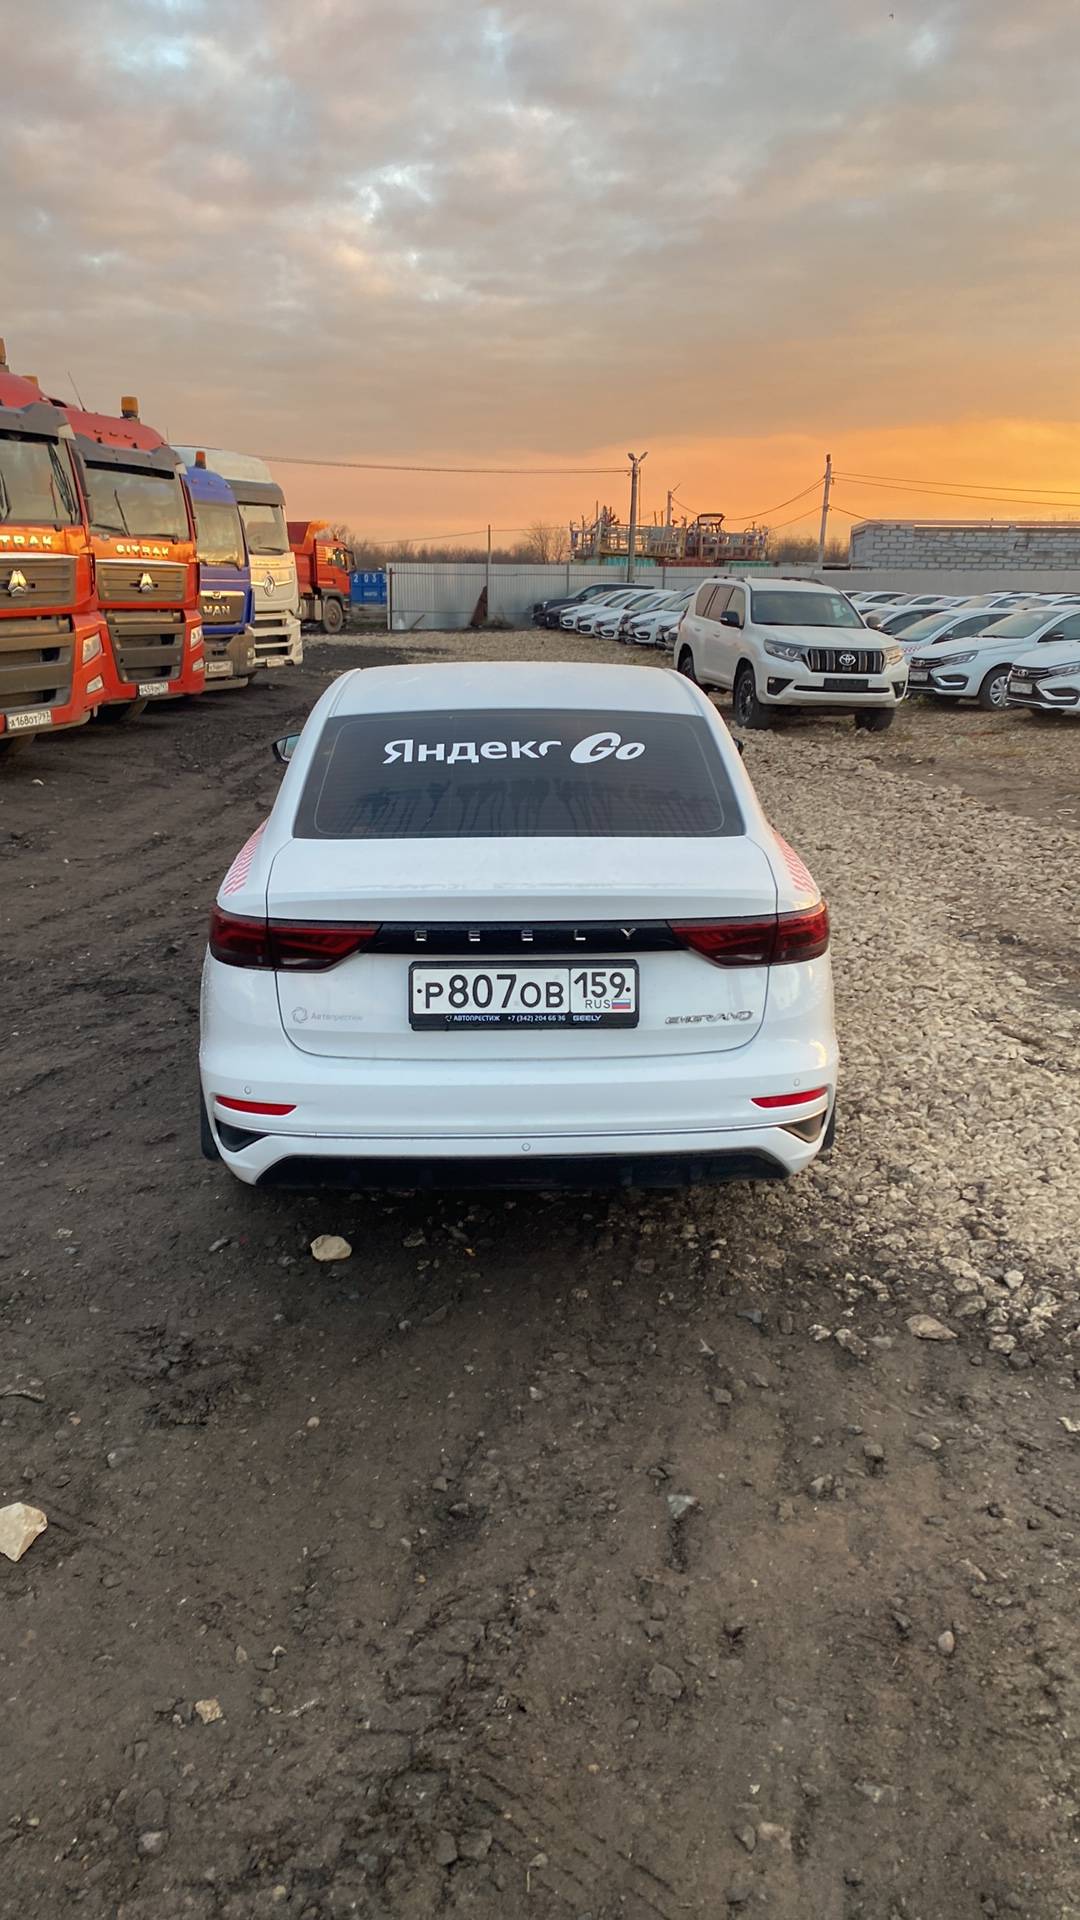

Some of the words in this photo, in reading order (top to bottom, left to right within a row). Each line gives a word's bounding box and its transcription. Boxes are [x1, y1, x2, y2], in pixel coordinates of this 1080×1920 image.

[116, 544, 169, 557] SITRAK
[203, 605, 230, 616] MAN
[570, 731, 646, 764] Go
[414, 928, 637, 942] GEELY
[425, 974, 564, 1009] Р807ОВ
[574, 972, 626, 999] 159
[585, 1000, 611, 1009] RUS
